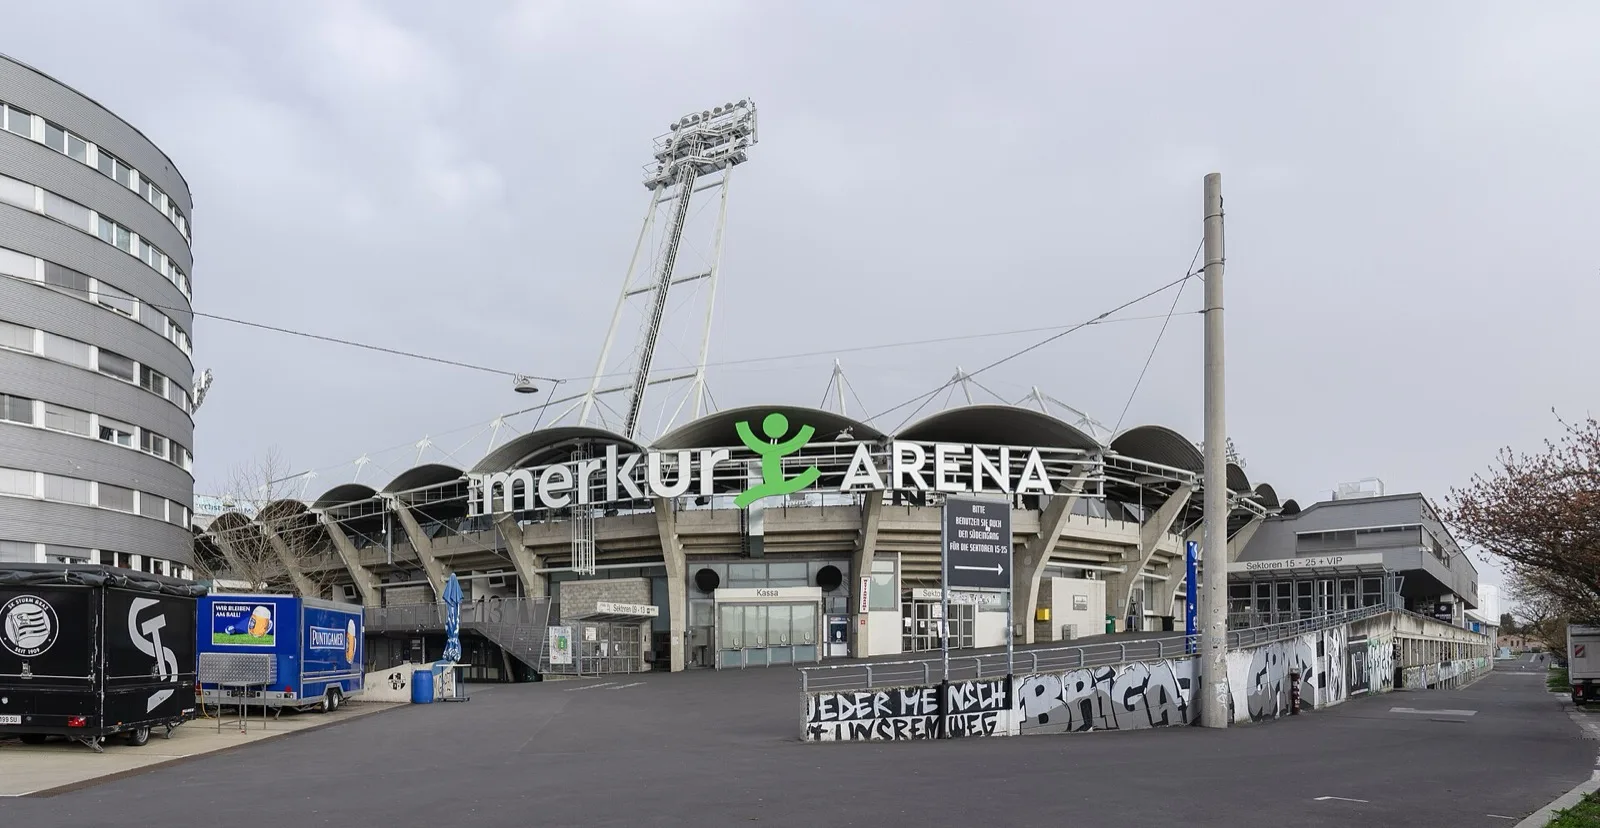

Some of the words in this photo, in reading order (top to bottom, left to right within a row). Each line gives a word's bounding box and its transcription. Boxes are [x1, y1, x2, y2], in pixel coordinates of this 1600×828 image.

[483, 444, 730, 515] merkur
[839, 441, 1054, 495] ARENA
[972, 505, 986, 514] BITTE
[955, 516, 980, 527] BENUTZEN
[958, 529, 969, 539] DEN
[949, 541, 960, 551] FÜR
[960, 543, 969, 552] DIE
[1246, 560, 1283, 570] Sektoren
[1285, 559, 1296, 568] 15
[1305, 558, 1317, 567] 25
[1326, 556, 1343, 566] VIP
[756, 588, 779, 597] Kassa
[922, 589, 942, 598] Sekto
[312, 629, 344, 646] PUNTIGAMER
